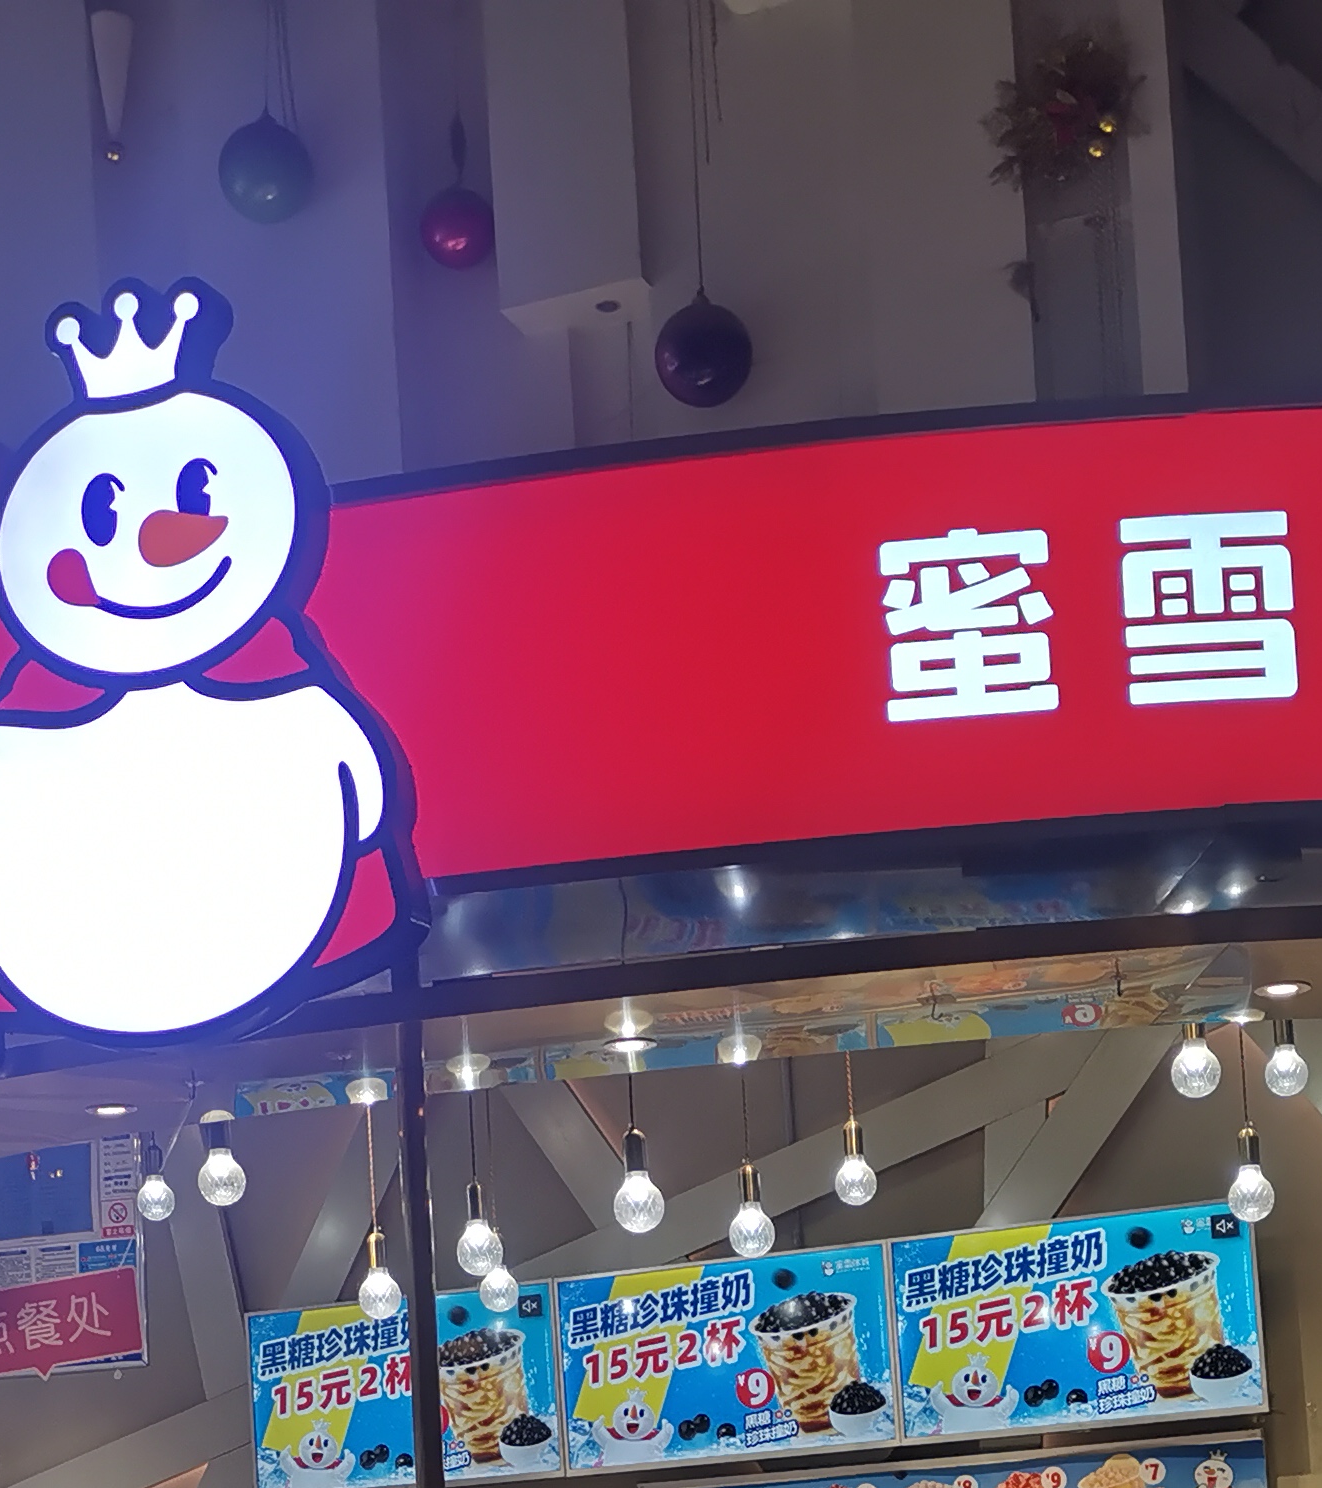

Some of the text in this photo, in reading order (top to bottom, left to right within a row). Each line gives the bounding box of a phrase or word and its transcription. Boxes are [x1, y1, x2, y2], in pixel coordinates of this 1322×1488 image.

[905, 1230, 1104, 1308] 黑糖珍珠撞奶
[570, 1272, 752, 1344] 黑糖珍珠撞奶
[920, 1279, 1095, 1350] 15元2杯
[585, 1319, 742, 1384] 15元2杯
